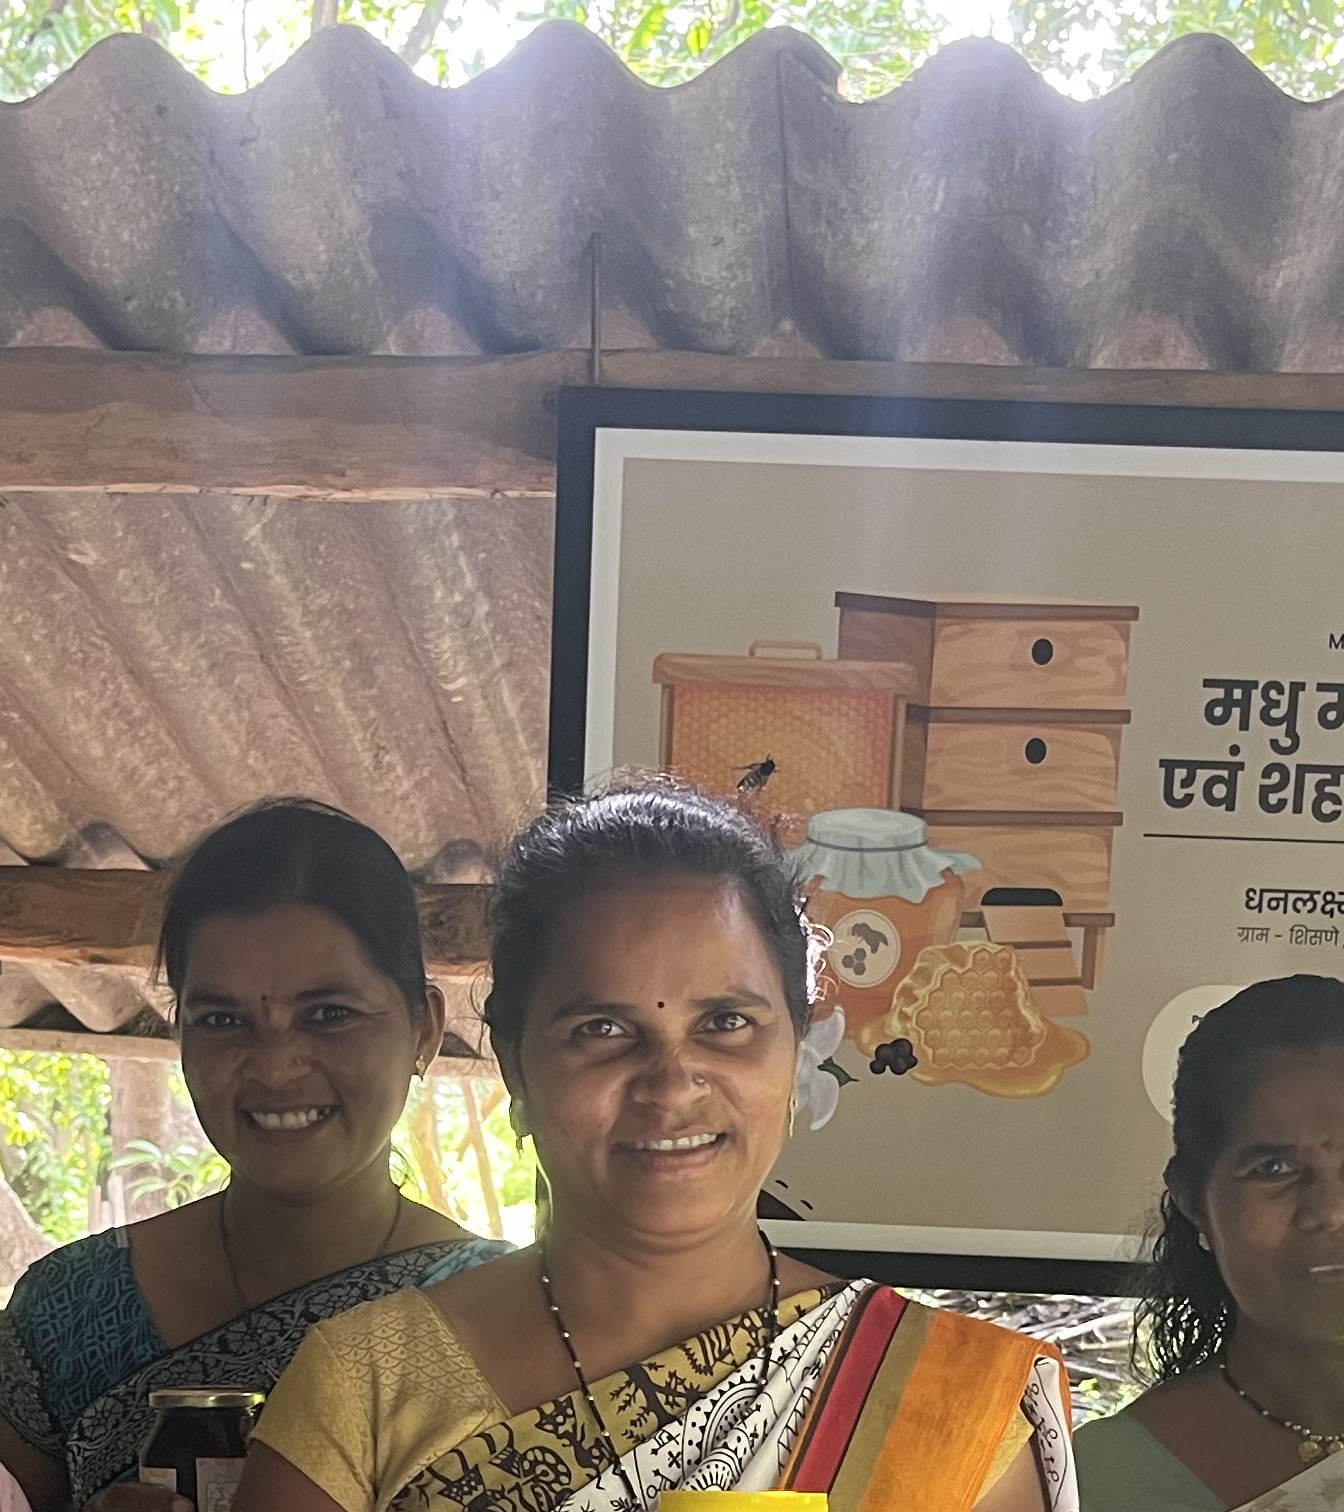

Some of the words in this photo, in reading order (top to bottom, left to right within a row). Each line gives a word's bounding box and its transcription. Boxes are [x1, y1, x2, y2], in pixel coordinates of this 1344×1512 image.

[1202, 678, 1306, 755] मधु
[1159, 744, 1245, 813] एवं
[1237, 926, 1270, 943] ग्राम
